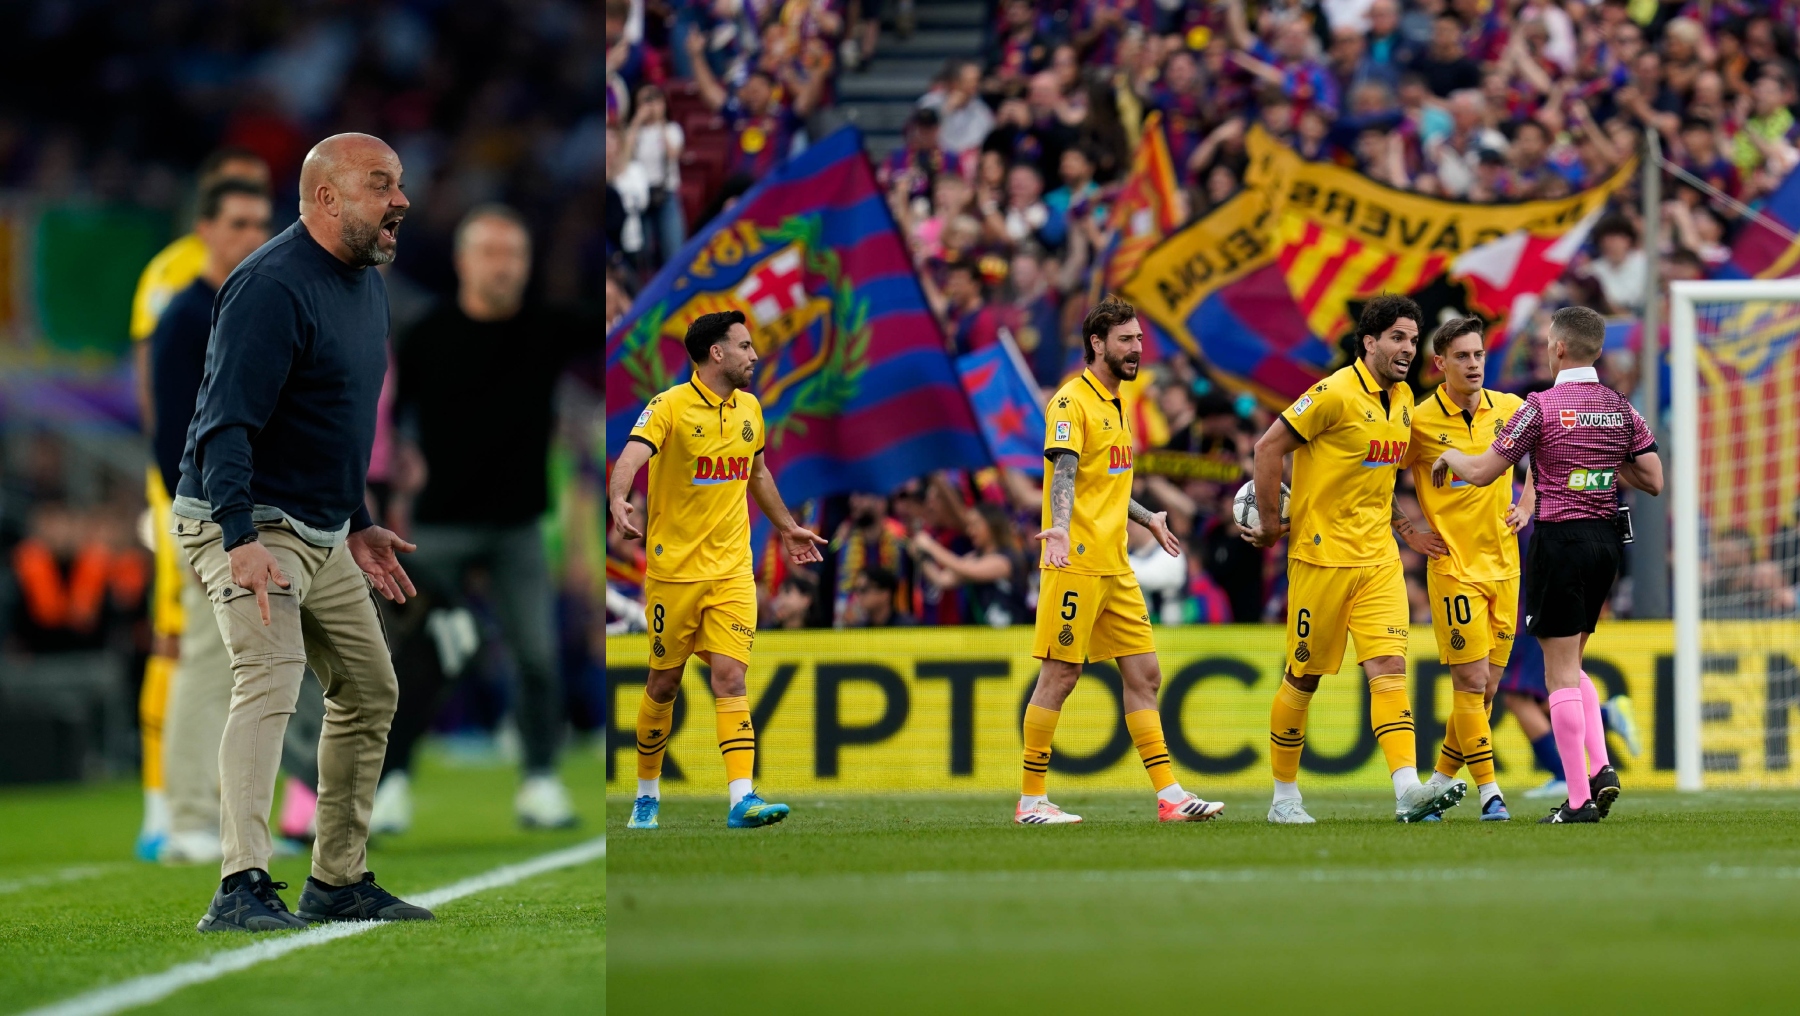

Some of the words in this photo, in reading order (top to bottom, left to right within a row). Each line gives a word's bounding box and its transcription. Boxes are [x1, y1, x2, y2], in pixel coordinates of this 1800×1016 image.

[1578, 413, 1623, 426] WÜRTH
[695, 456, 749, 480] DANI
[1568, 472, 1613, 487] BKT
[653, 603, 665, 633] 8
[1061, 591, 1078, 620] 5
[1443, 595, 1471, 625] 10
[1297, 608, 1311, 638] 6
